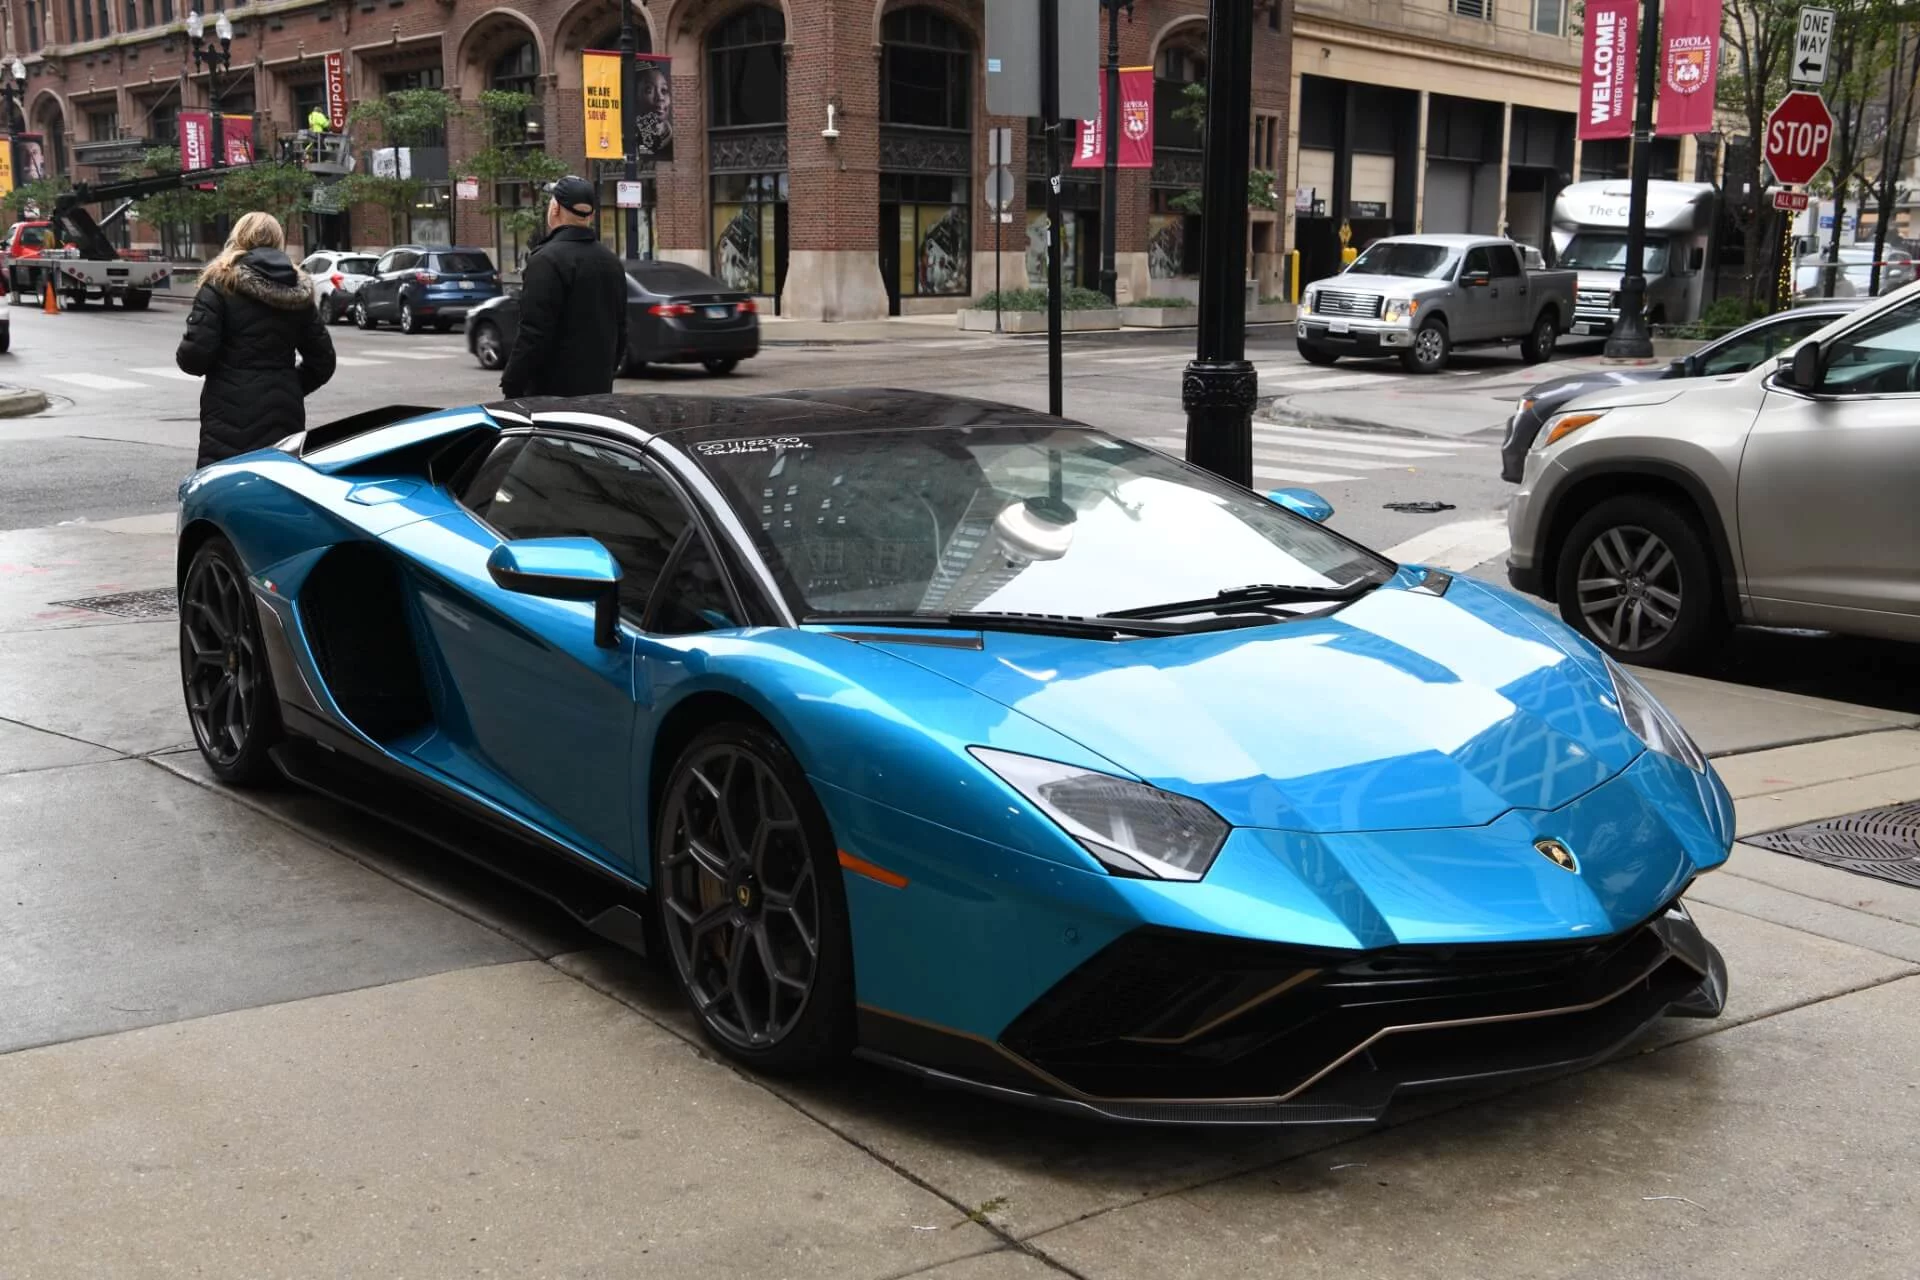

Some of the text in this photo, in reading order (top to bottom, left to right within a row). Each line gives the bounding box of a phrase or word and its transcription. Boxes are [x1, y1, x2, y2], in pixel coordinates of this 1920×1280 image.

[1803, 14, 1829, 33] ONE
[1670, 35, 1711, 48] LOYOLA
[1800, 35, 1827, 54] WAY
[1591, 11, 1616, 125] WELCOME
[1613, 17, 1628, 117] WATER TOWER CAMPUS
[330, 57, 343, 128] CHIPOTLE
[587, 86, 610, 97] WE ARE
[588, 98, 619, 110] CALLED TO
[1769, 120, 1828, 157] STOP
[1588, 204, 1613, 216] The
[1777, 193, 1806, 208] ALL WAY
